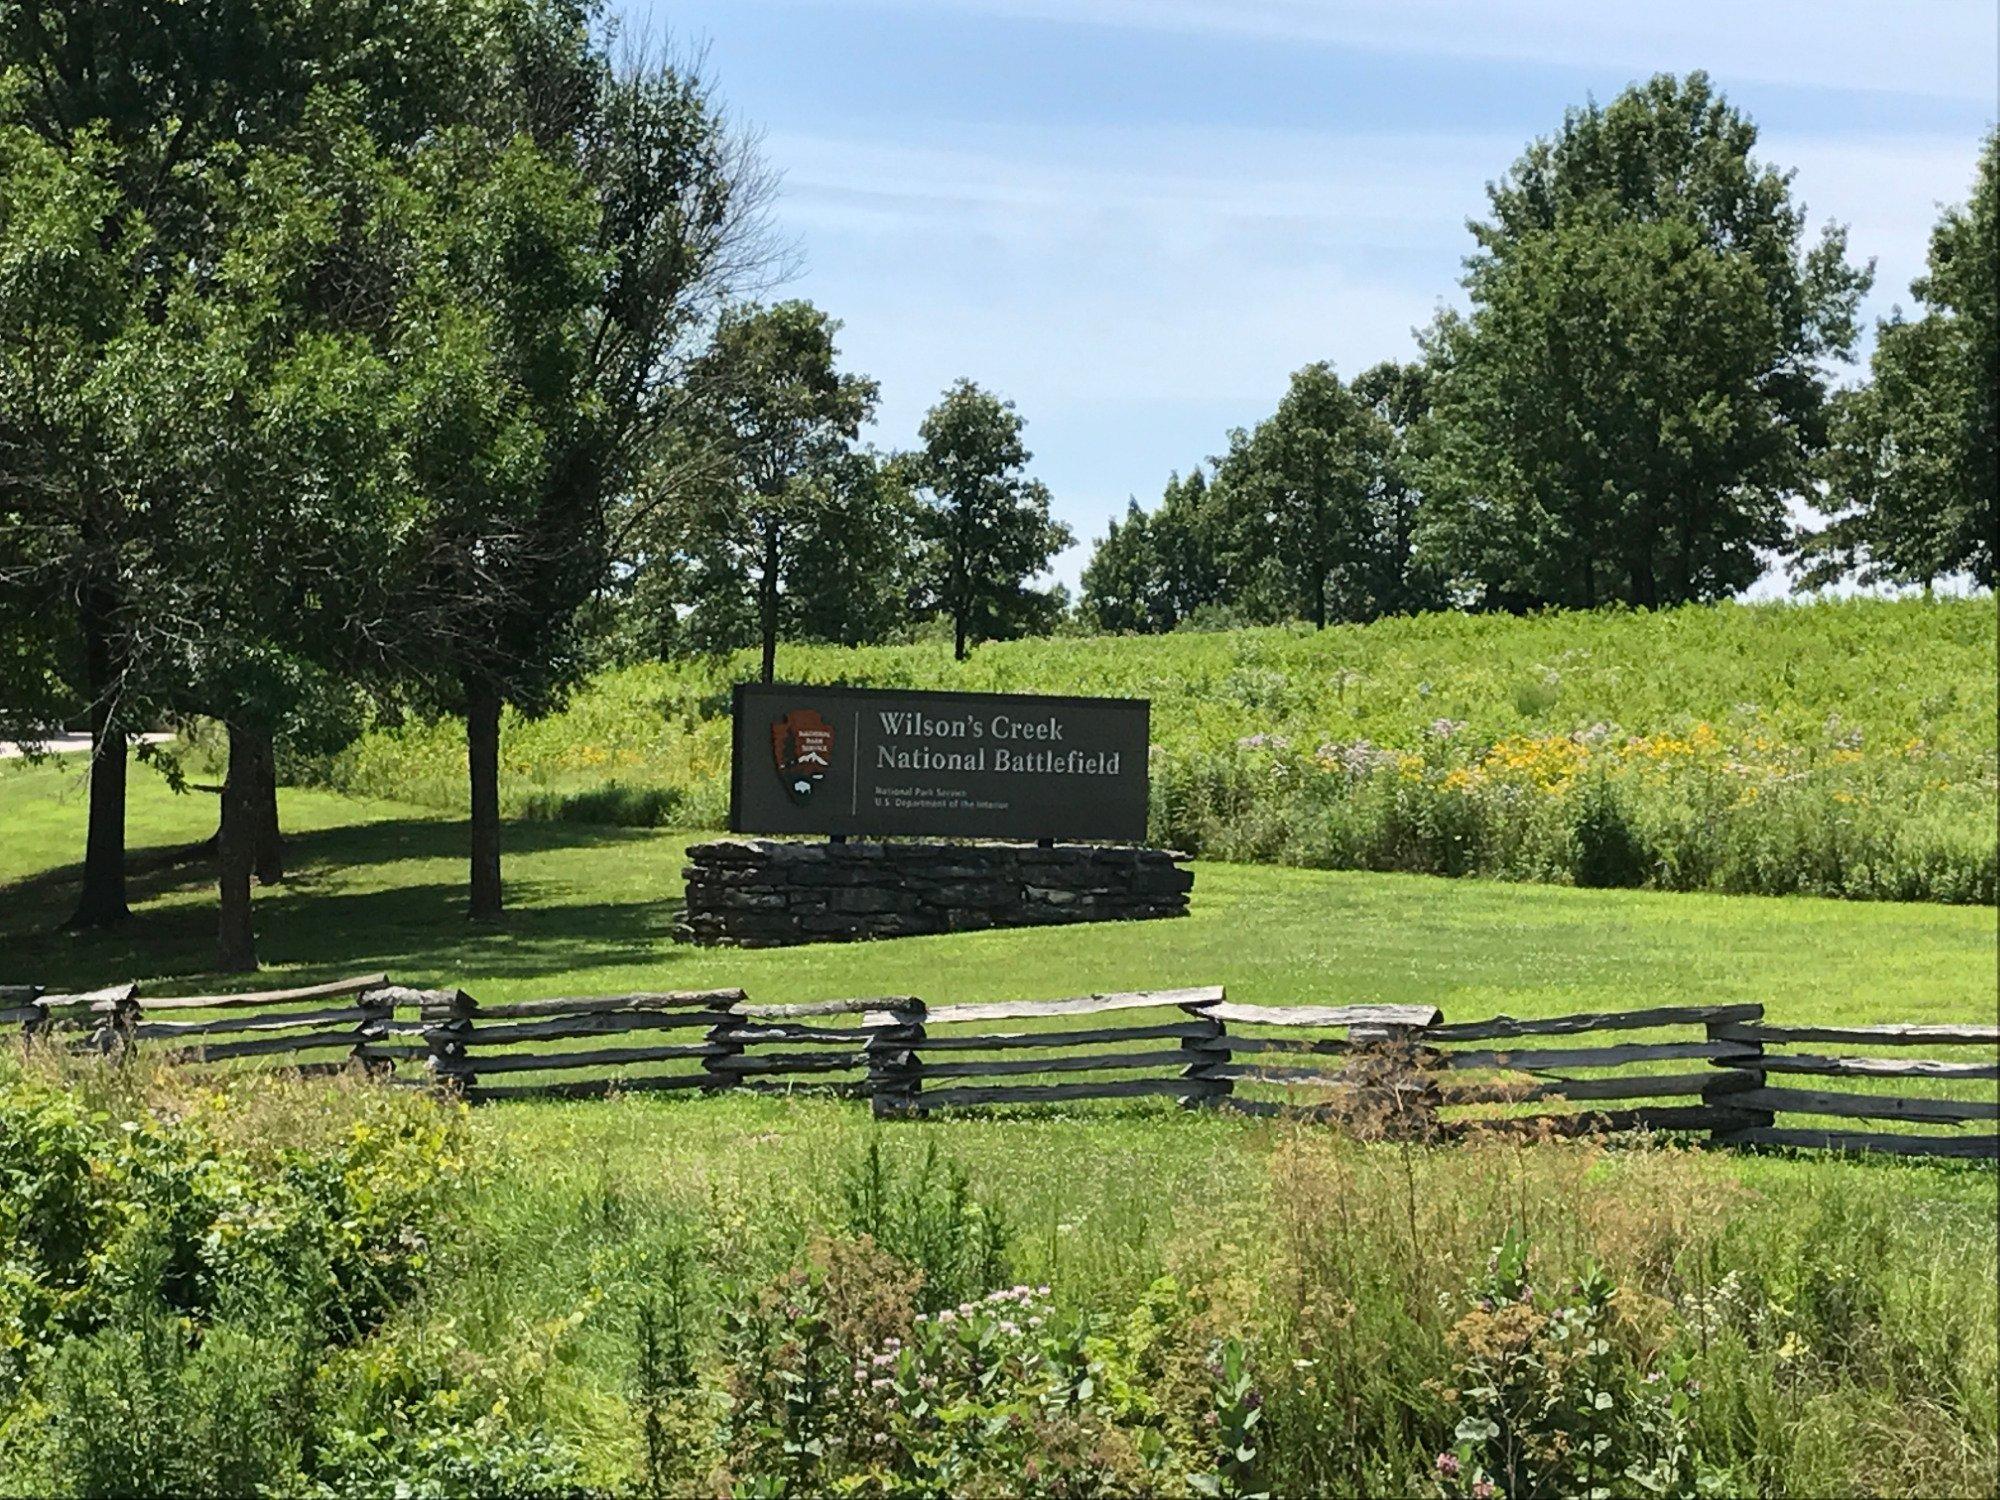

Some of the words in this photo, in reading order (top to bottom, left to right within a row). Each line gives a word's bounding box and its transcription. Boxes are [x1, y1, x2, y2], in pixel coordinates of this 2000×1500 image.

[878, 712, 983, 738] Wilson's
[991, 716, 1063, 741] Creek
[877, 745, 985, 771] National
[994, 749, 1120, 775] Battlefield
